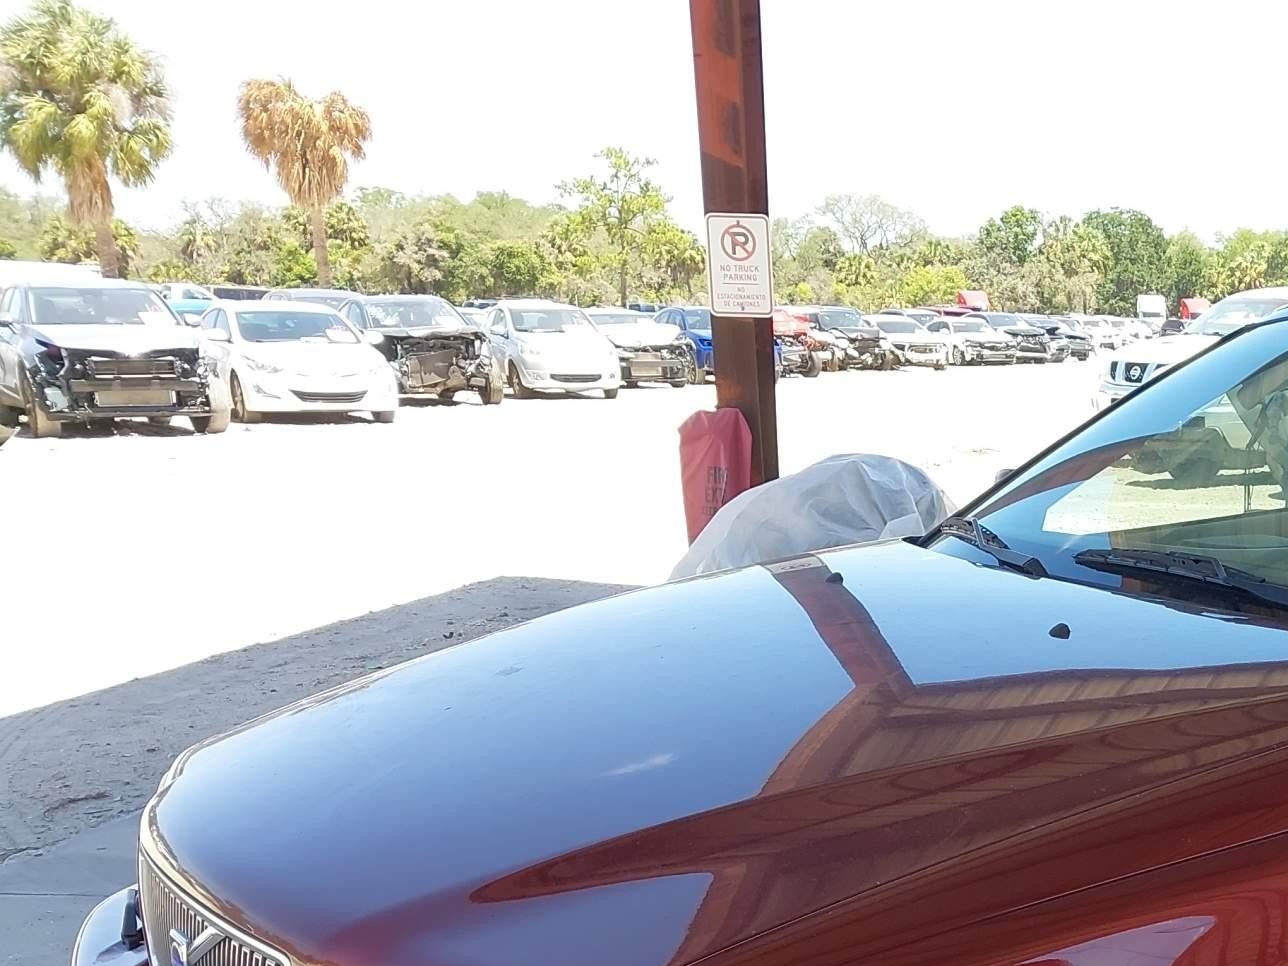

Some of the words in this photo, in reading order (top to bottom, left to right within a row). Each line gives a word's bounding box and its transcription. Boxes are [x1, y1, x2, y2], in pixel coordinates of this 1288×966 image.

[719, 264, 731, 272] NO
[734, 264, 760, 273] TRUCK
[723, 273, 758, 281] PARKING
